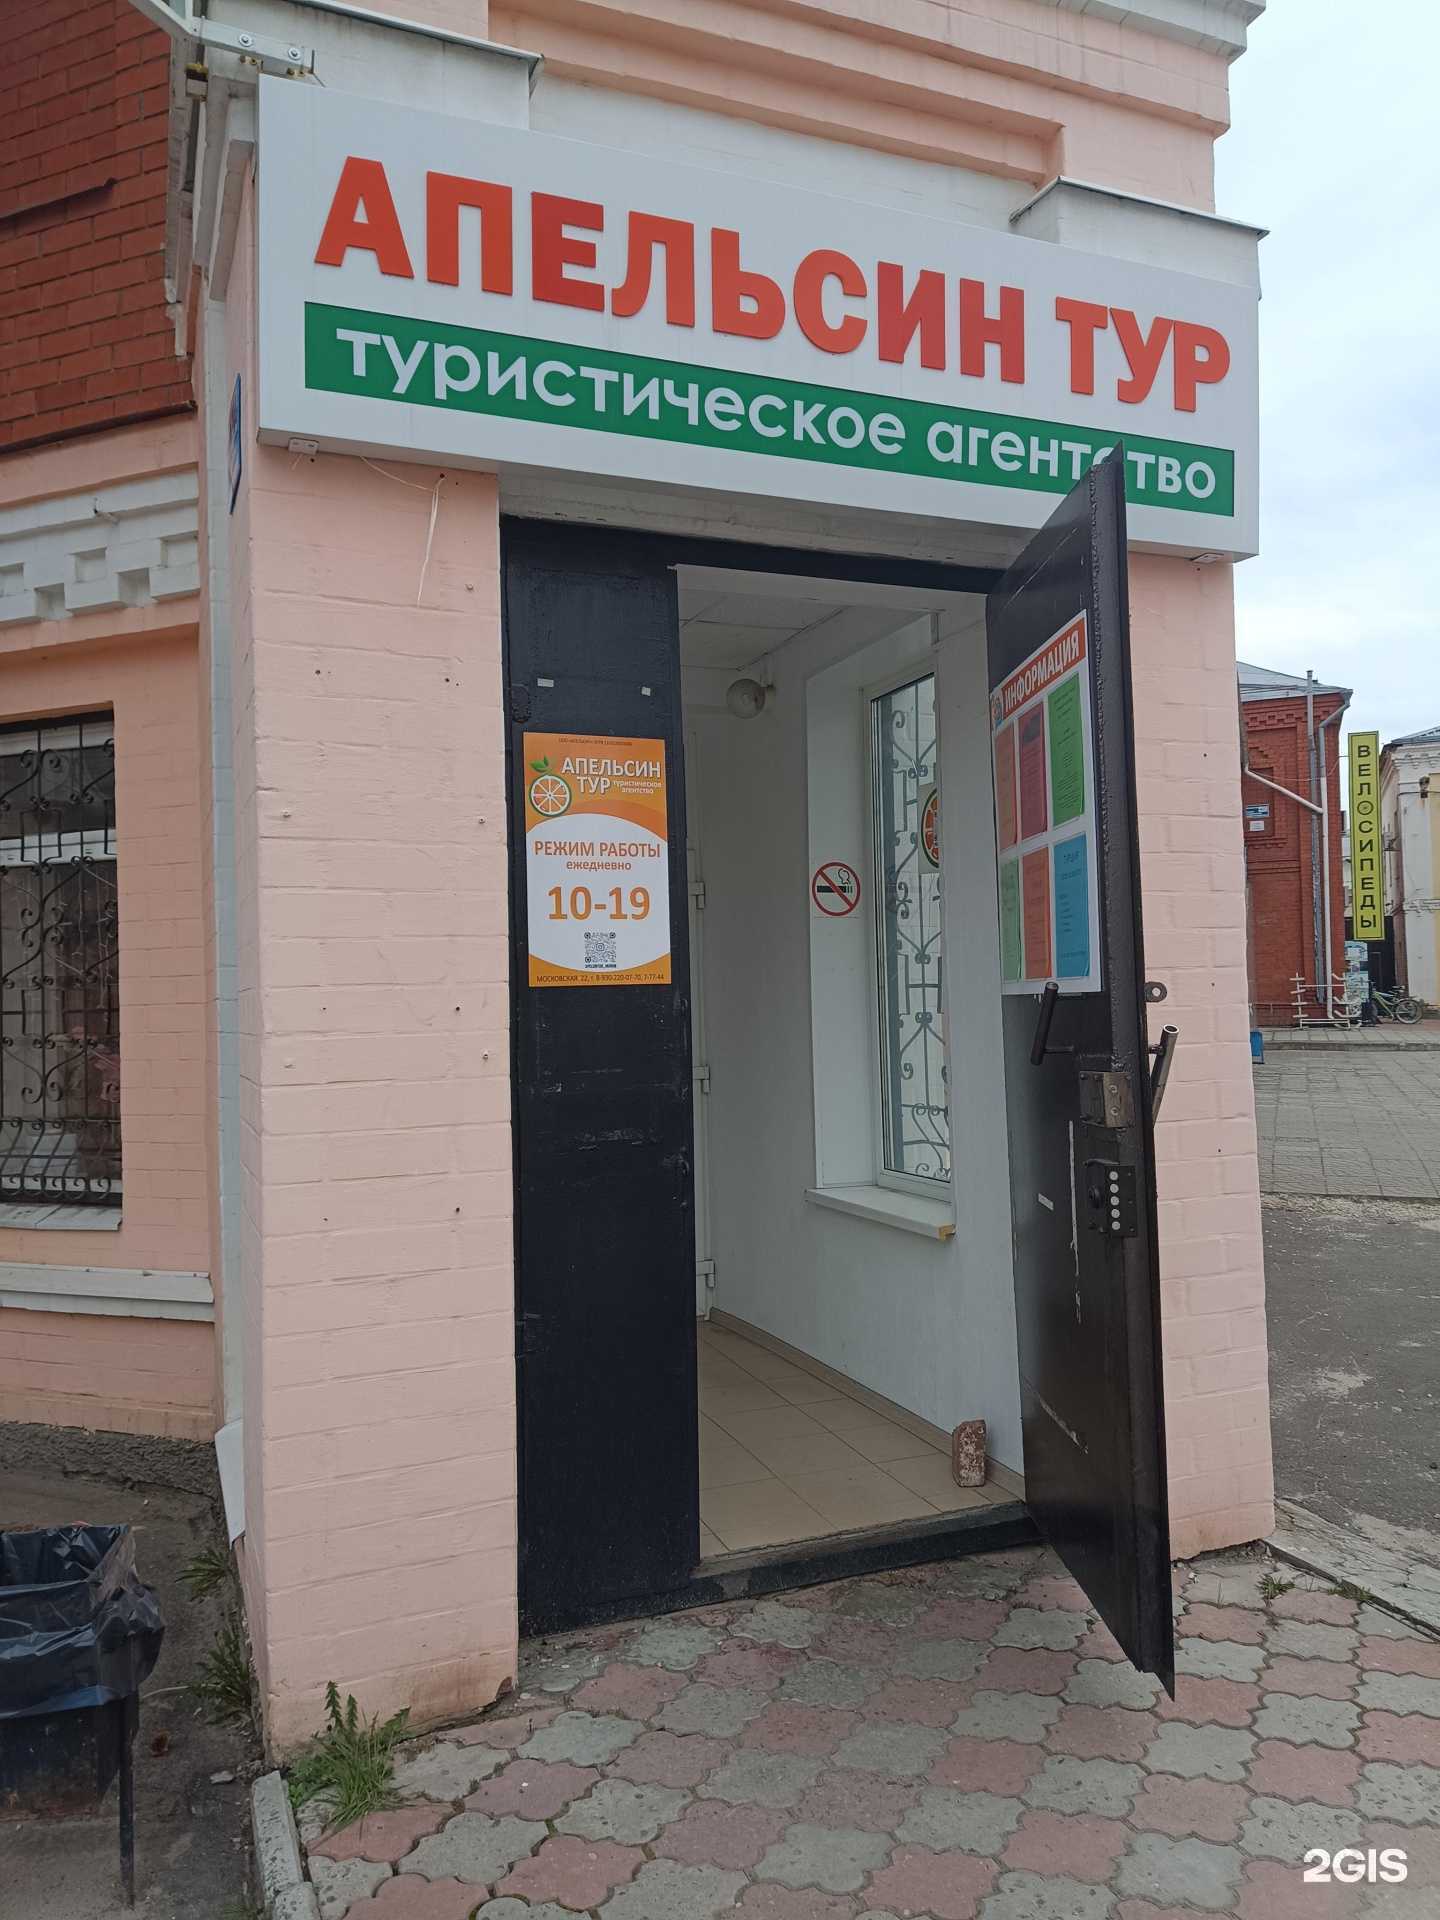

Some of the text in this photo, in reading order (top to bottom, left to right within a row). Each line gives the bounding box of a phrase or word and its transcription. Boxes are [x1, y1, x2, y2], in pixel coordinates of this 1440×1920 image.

[314, 156, 1230, 412] АПЕЛЬСИН ТУР
[336, 328, 906, 455] туристическое
[1005, 630, 1080, 713] ИНФОРМАЦИЯ
[561, 757, 661, 778] АПЕЛЬСИН
[576, 776, 611, 794] ТУР
[534, 840, 661, 858] РЕЖИМ РАБОТЫ
[1357, 745, 1377, 928] ВЕЛОСИПЕДЫ
[566, 861, 632, 871] ежедневно
[548, 886, 650, 920] 10-19
